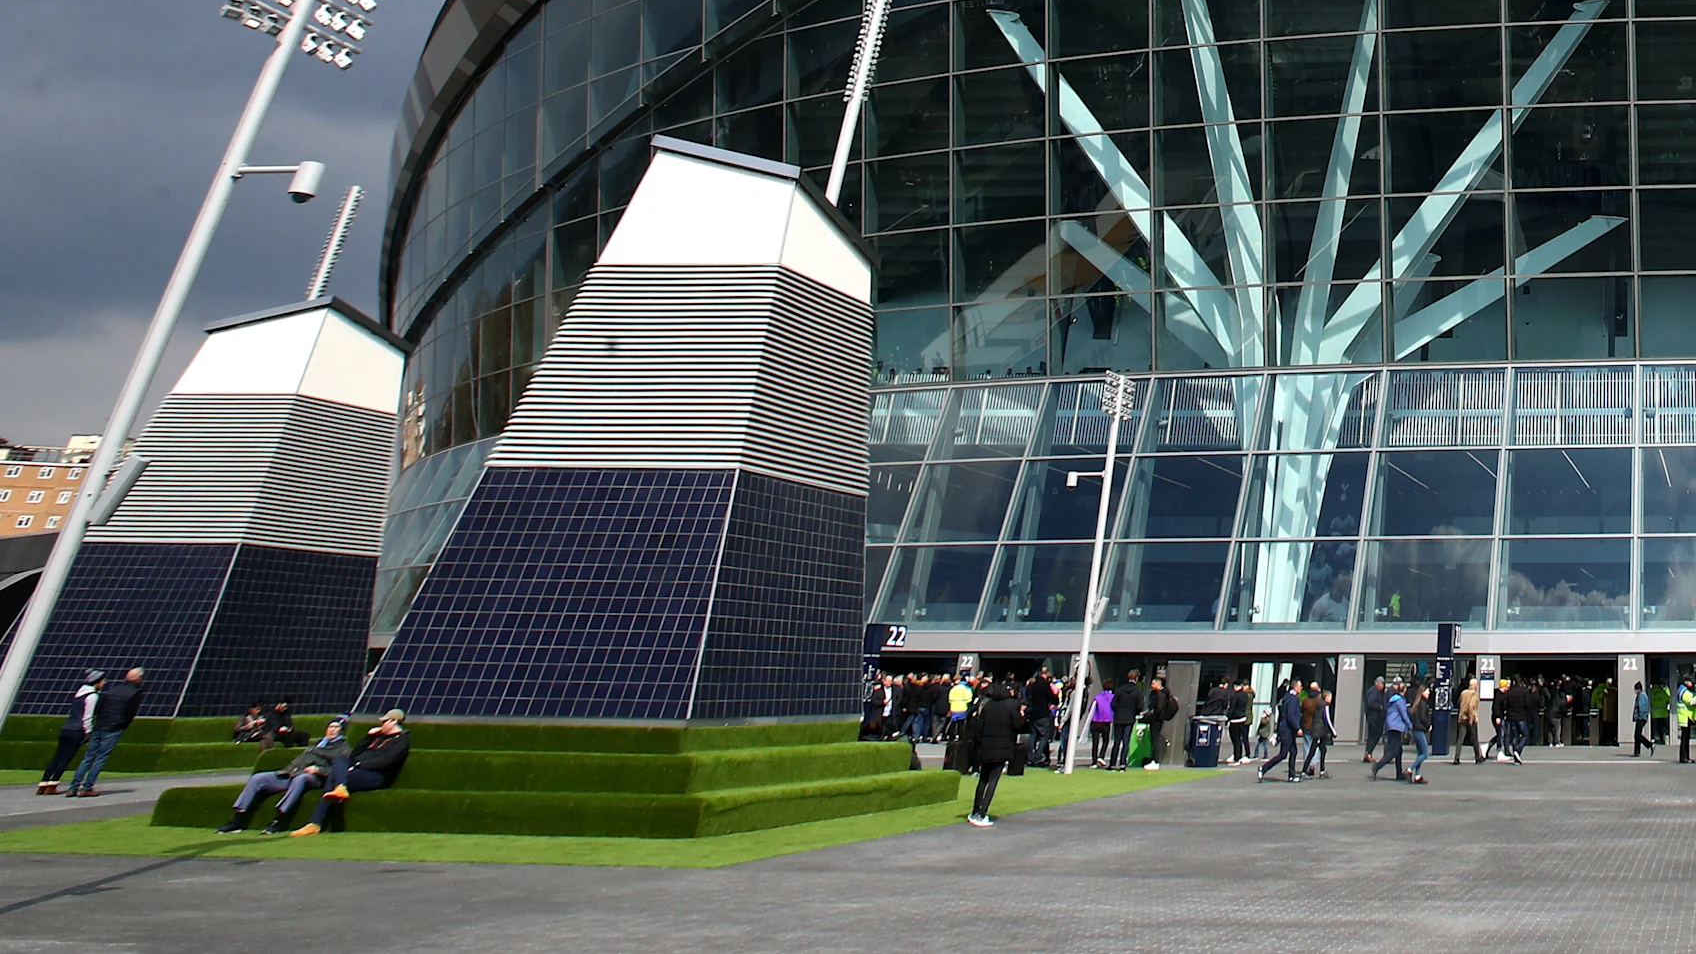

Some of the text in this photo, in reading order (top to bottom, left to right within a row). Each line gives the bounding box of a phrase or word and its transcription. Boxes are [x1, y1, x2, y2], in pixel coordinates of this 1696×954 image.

[886, 626, 906, 646] 22
[961, 656, 973, 667] 22
[1343, 658, 1357, 670] 21
[1480, 658, 1495, 670] 21
[1623, 658, 1638, 670] 21
